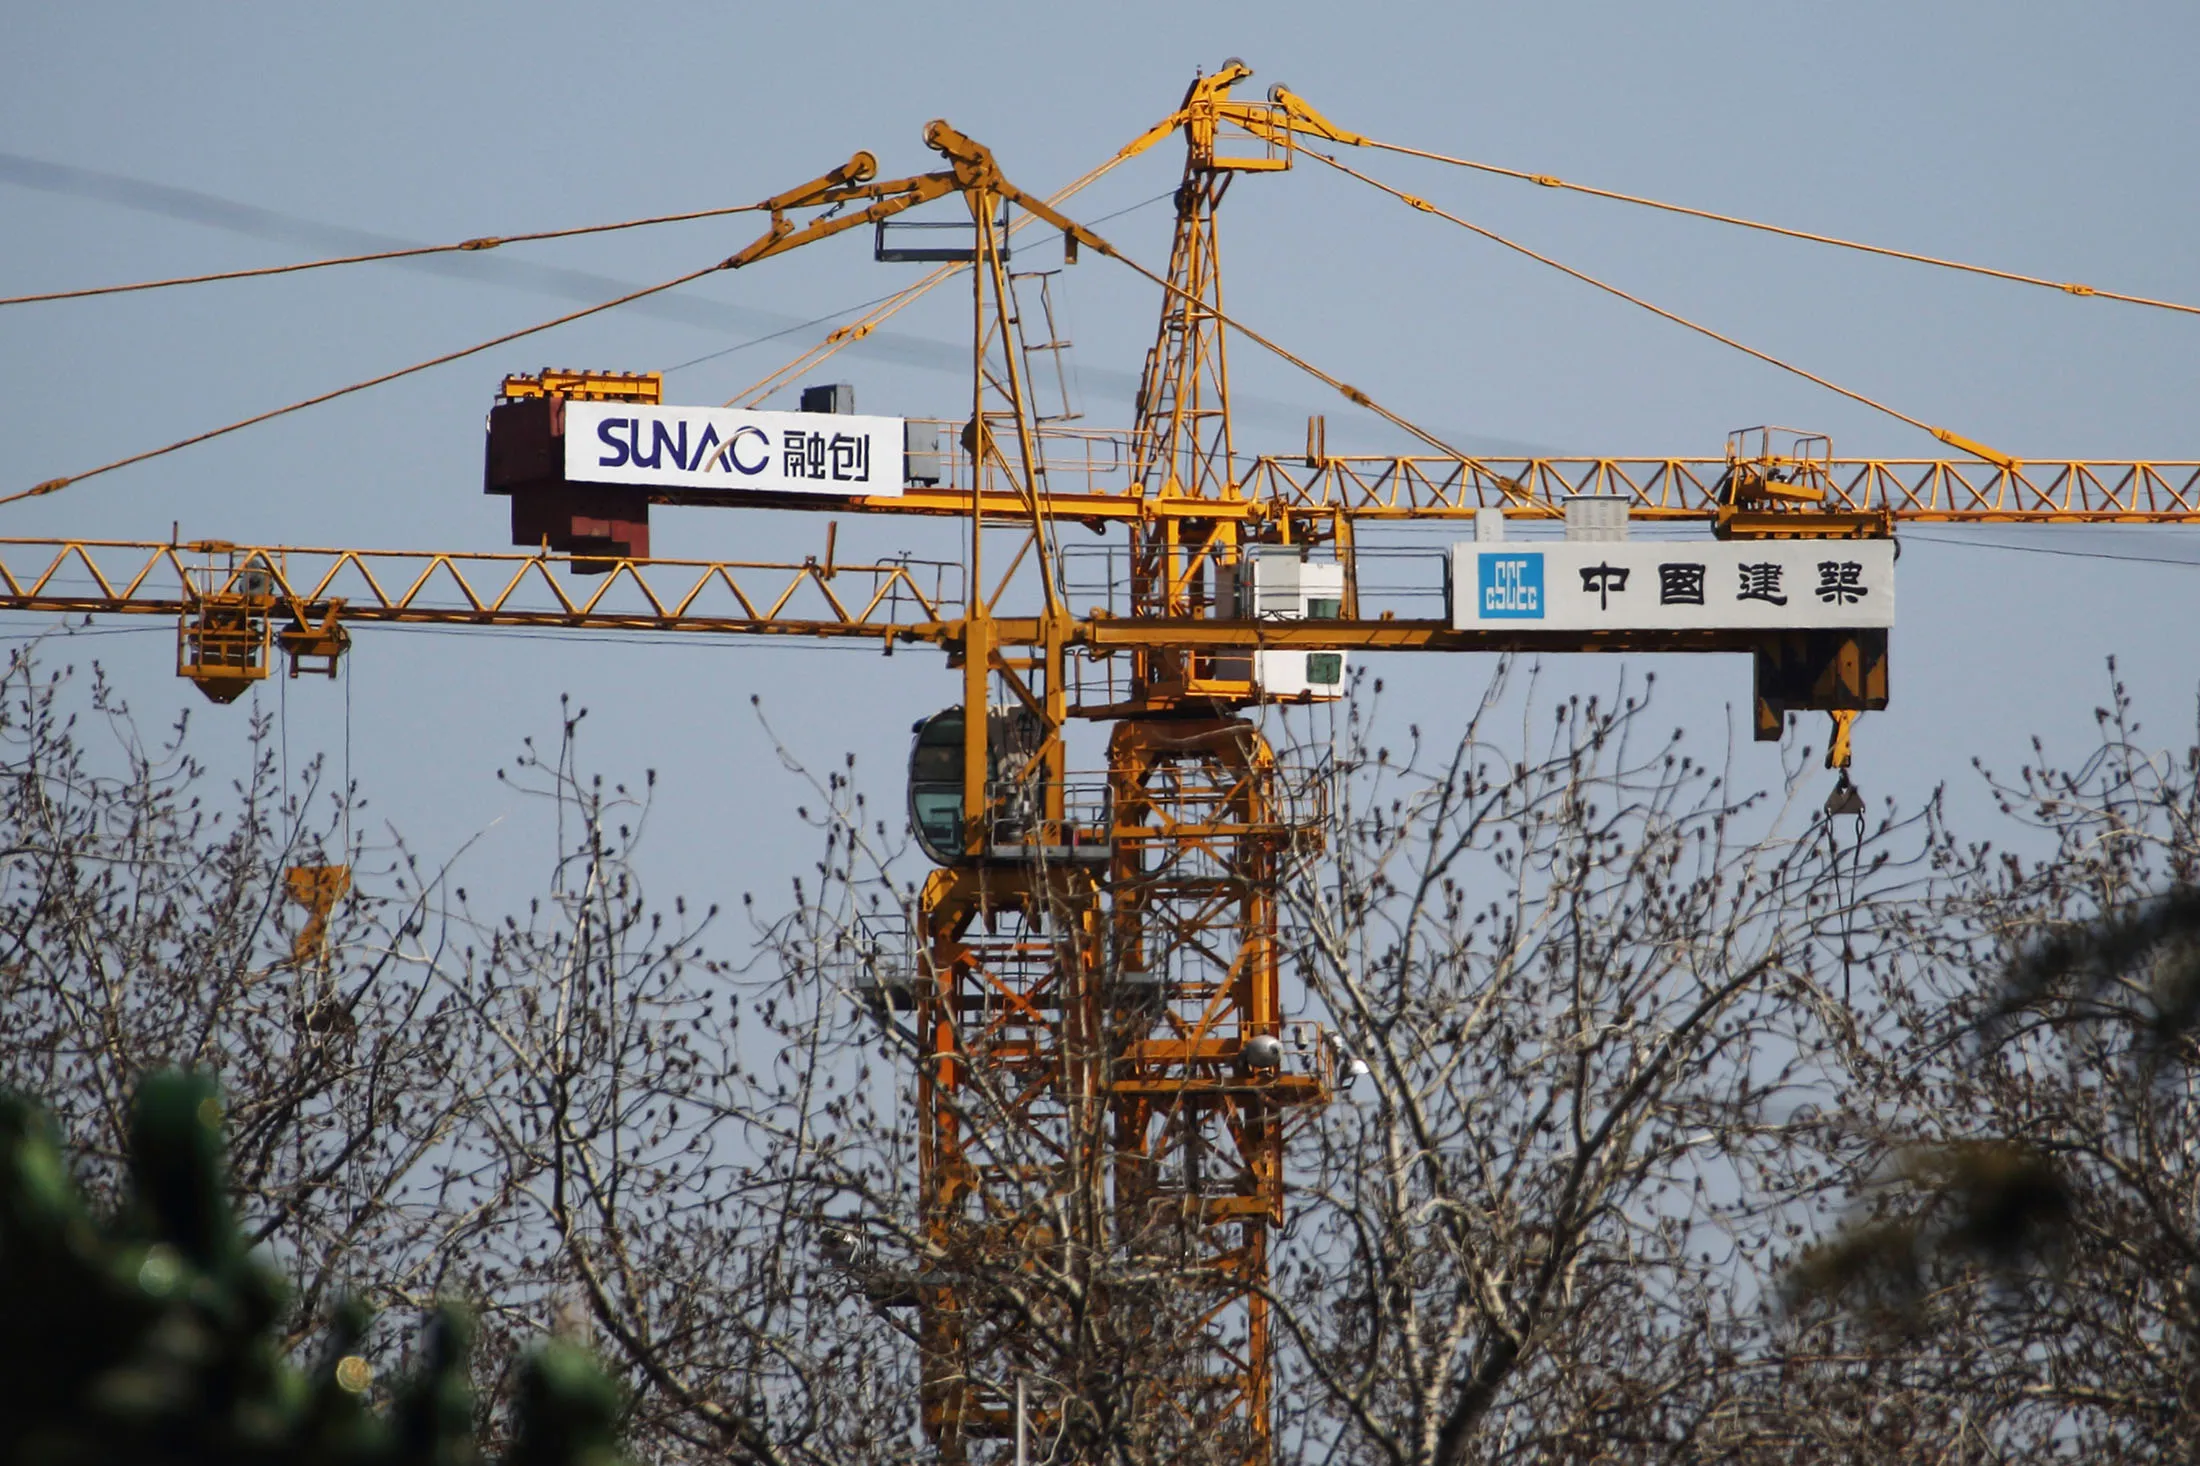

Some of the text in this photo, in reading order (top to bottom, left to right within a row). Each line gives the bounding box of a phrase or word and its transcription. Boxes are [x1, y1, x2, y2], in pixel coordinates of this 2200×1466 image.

[596, 418, 870, 483] SUNAC 融创
[1578, 560, 1869, 611] 中國建築
